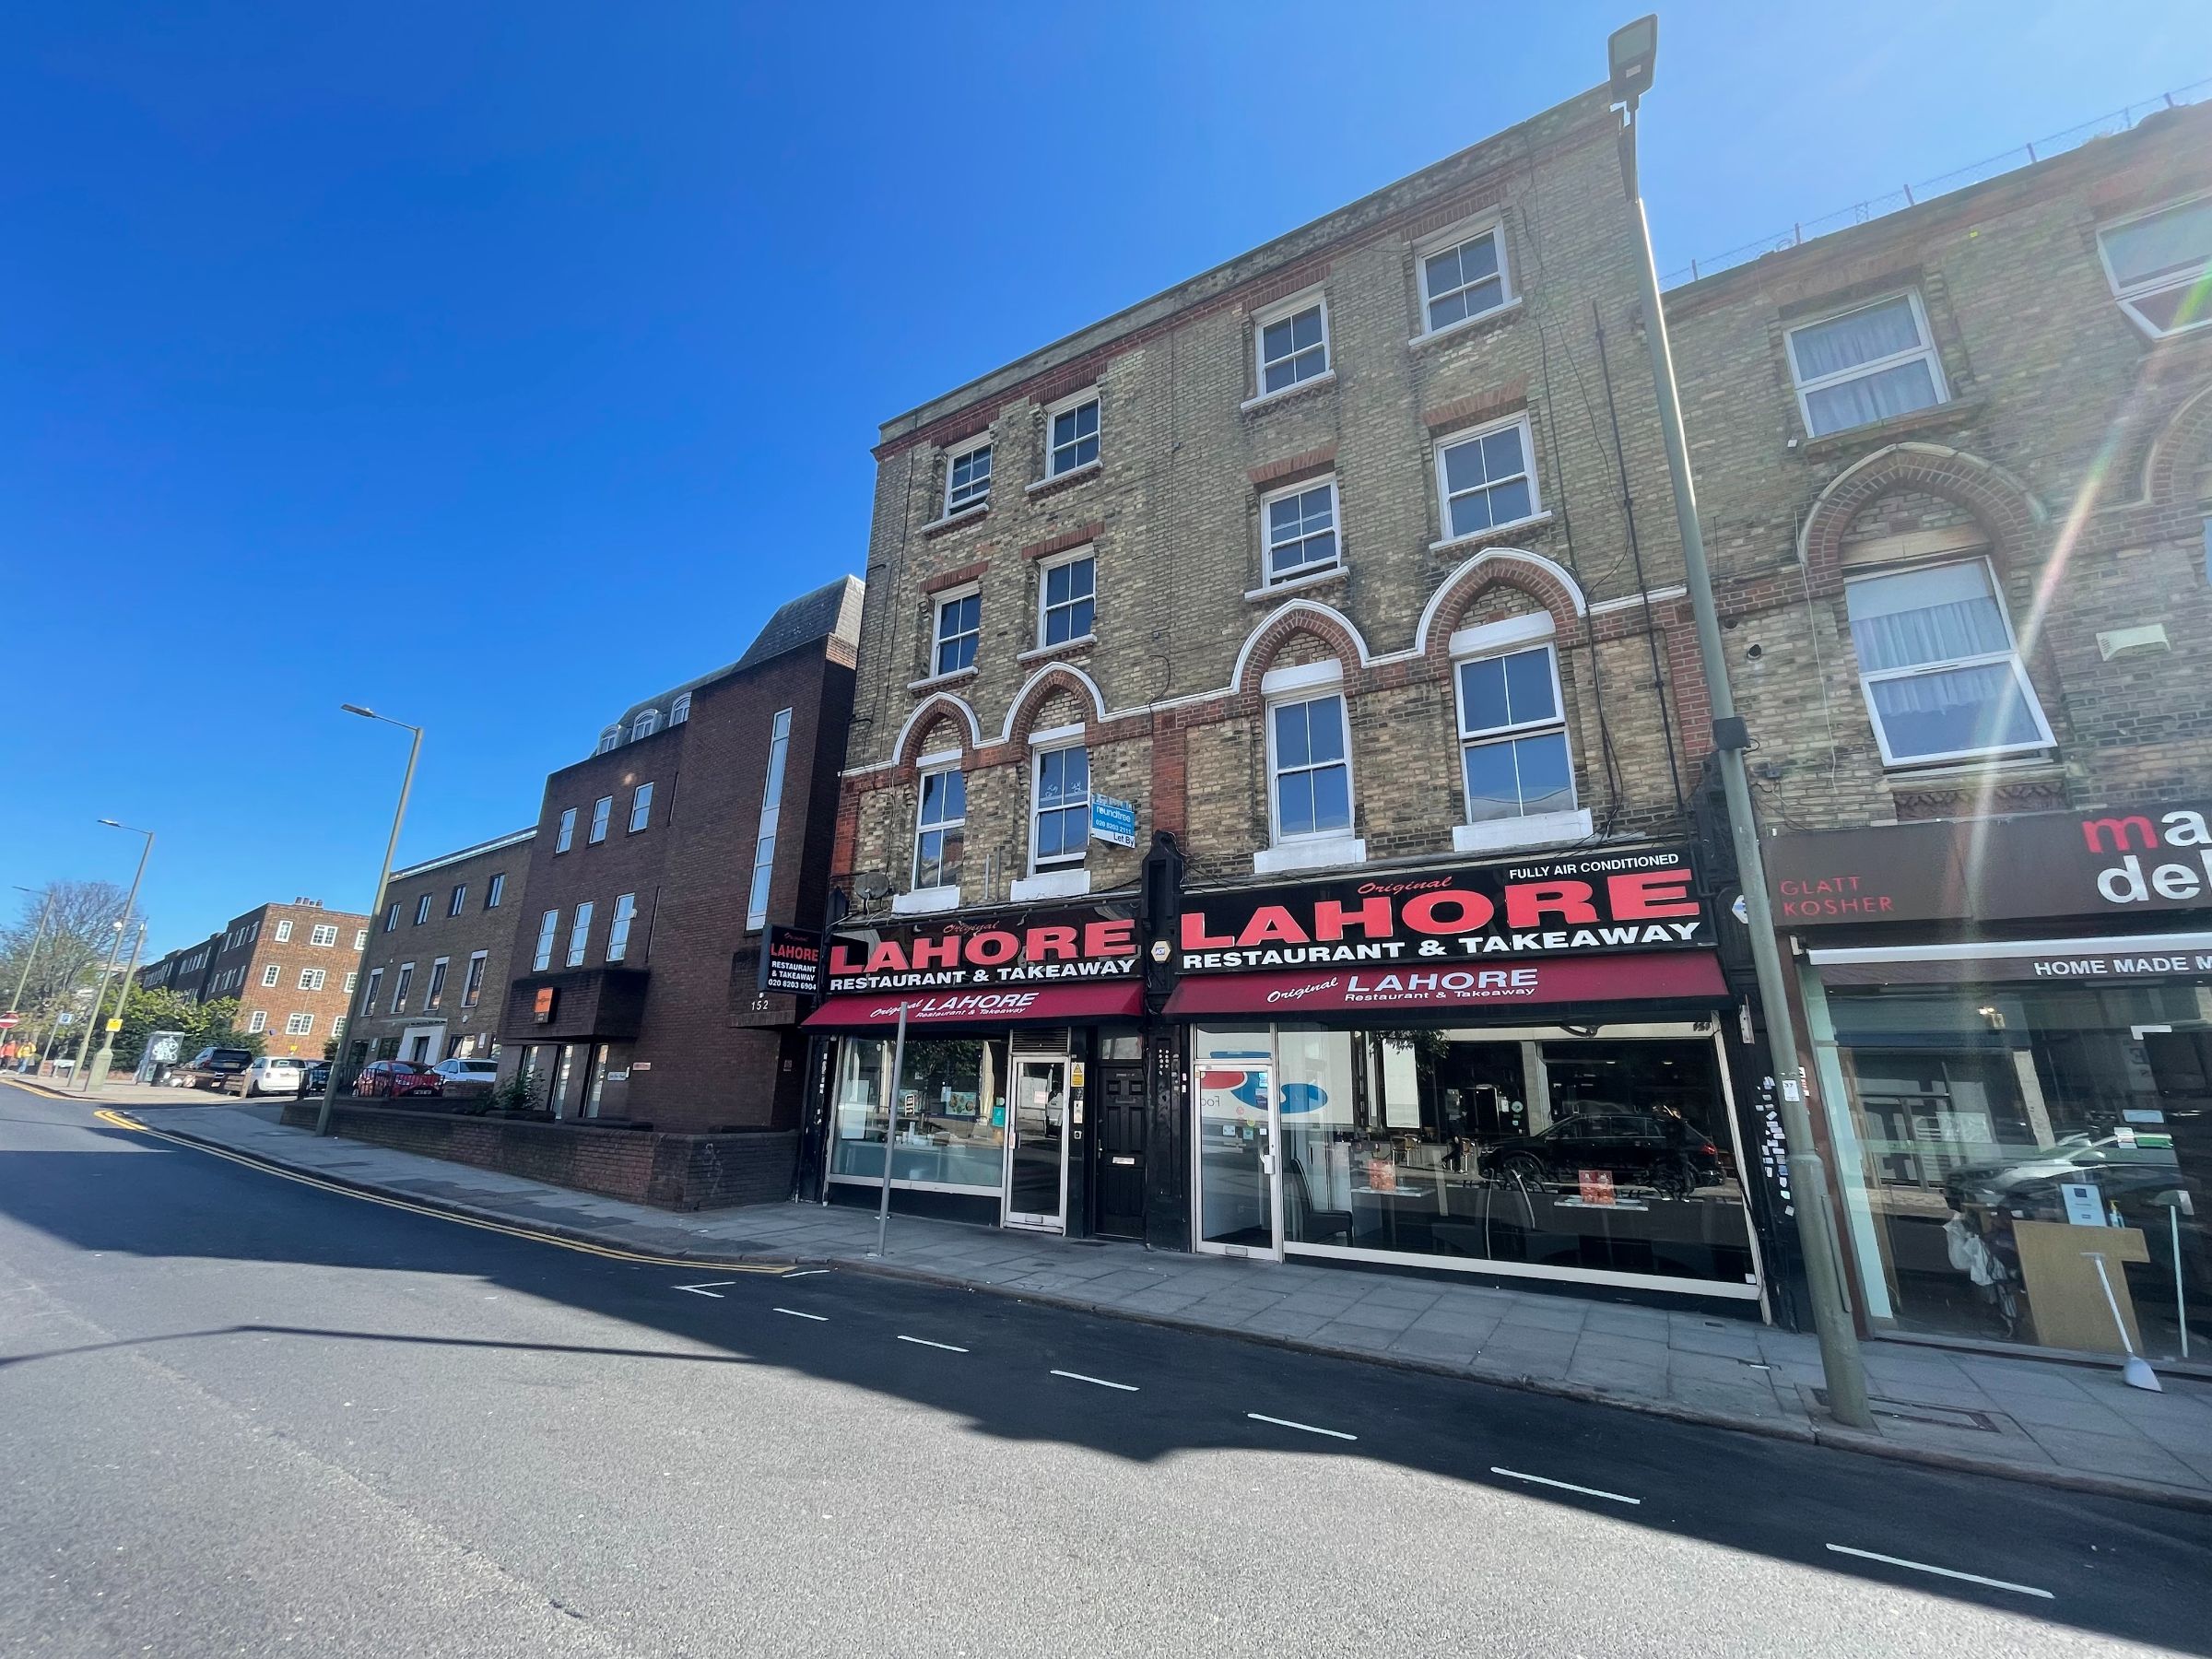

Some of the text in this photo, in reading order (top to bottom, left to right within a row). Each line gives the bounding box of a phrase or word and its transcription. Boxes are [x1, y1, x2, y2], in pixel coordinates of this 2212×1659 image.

[1097, 806, 1131, 822] roundtree
[1113, 832, 1134, 847] Let By
[1509, 853, 1679, 879] FULLY AIR CONDITIONED
[1358, 876, 1453, 896] Original
[1781, 877, 1860, 895] GLATT
[1181, 868, 1701, 950] LAHORE
[1783, 896, 1894, 916] KOSHER
[771, 943, 819, 962] LAHORE
[830, 919, 1137, 975] LAHORE
[1183, 922, 1701, 969] RESTAURANT & TAKEAWAY
[771, 960, 817, 973] RESTAURANT
[830, 959, 1135, 991] RESTAURANT & TAKEAWAY
[2033, 959, 2108, 976] HOME
[2112, 957, 2190, 973] MADE
[768, 979, 817, 990] 020 8203 6904
[779, 971, 815, 982] TAKEAWAY
[1266, 969, 1538, 1003] Original LAHORE
[922, 992, 1040, 1012] LAHORE
[1345, 988, 1535, 1002] Restaurant & Takeaway
[751, 1000, 769, 1011] 152
[915, 1009, 966, 1018] Restaurant
